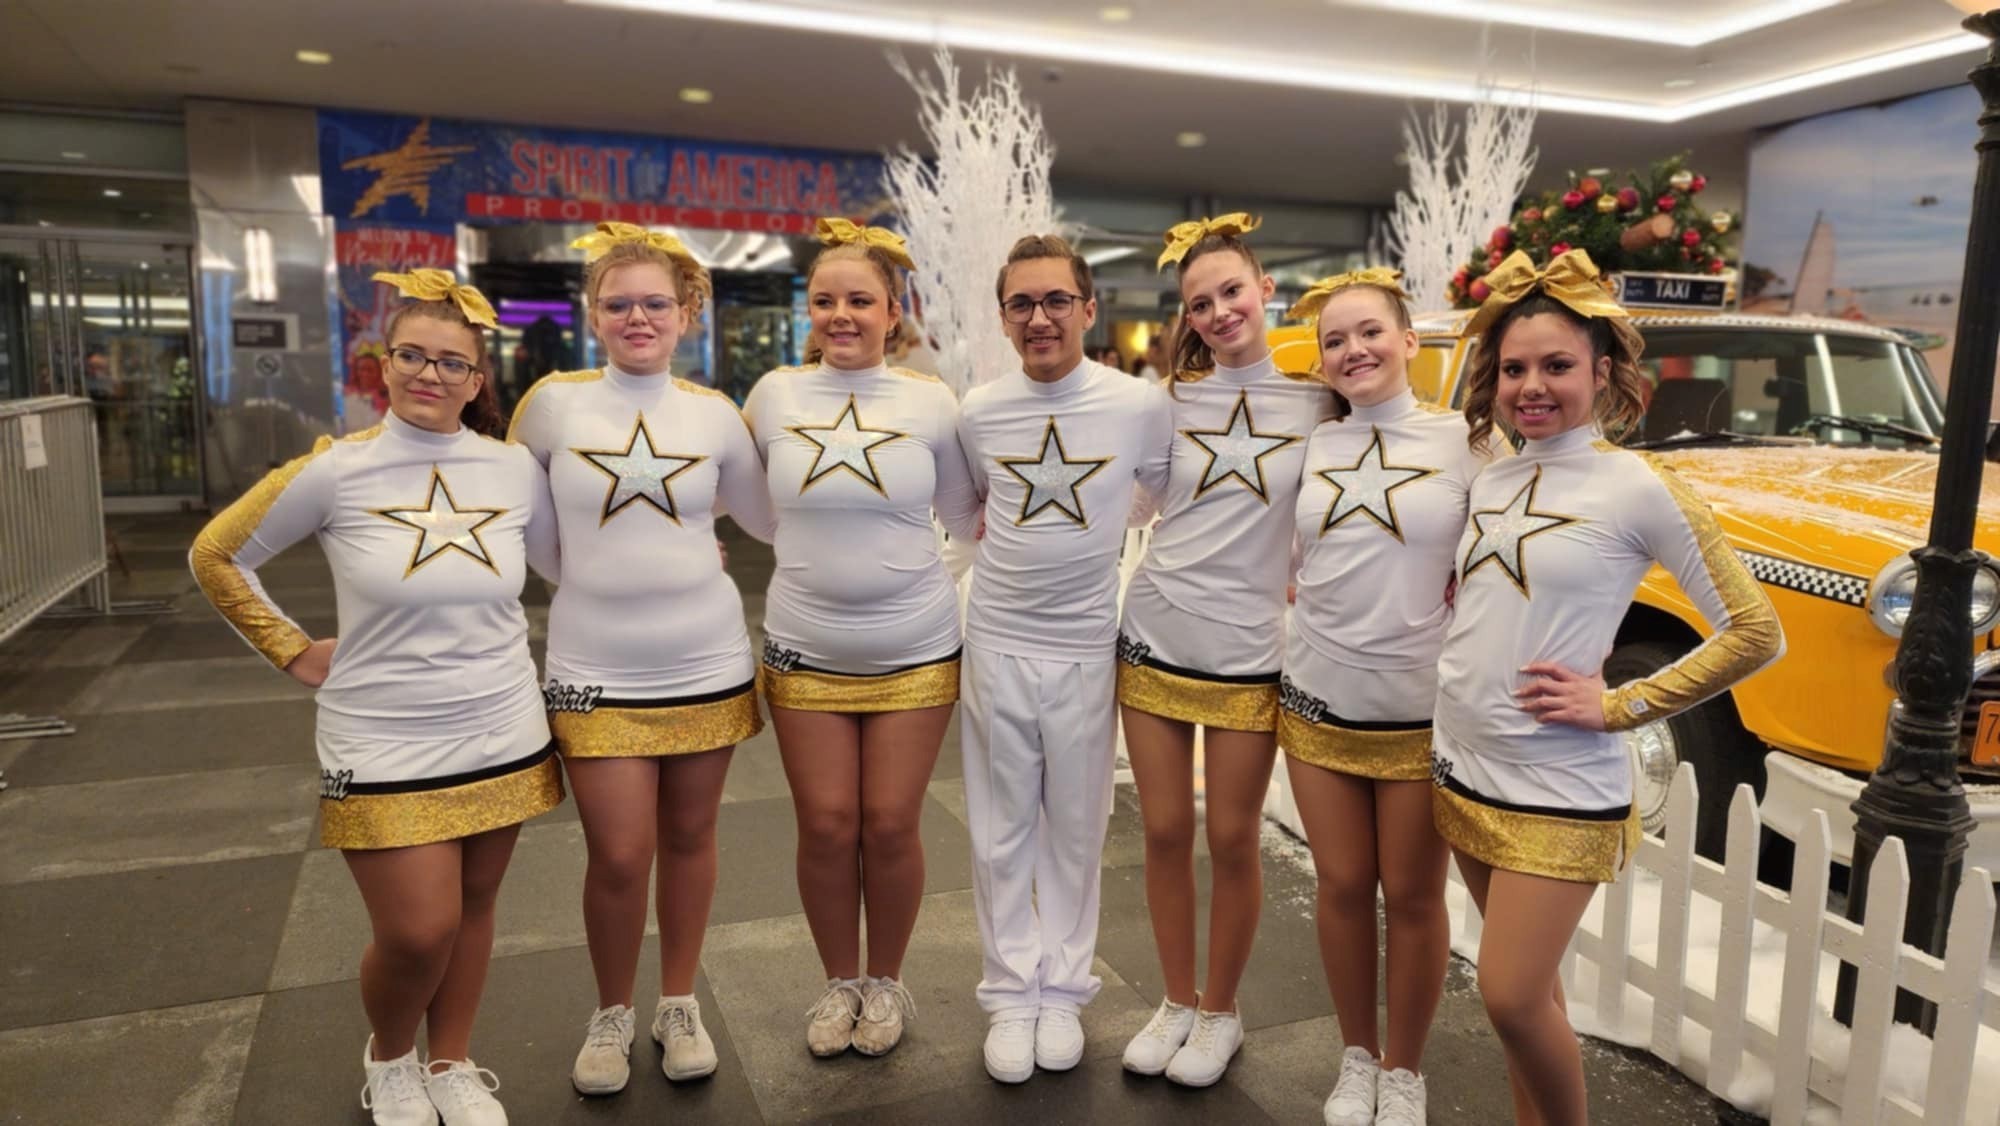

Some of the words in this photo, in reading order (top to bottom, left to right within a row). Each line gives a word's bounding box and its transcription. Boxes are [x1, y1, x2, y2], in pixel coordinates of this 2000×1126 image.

[511, 139, 634, 199] SPIRIT
[666, 148, 841, 213] AMERICA
[485, 196, 818, 236] PRODUCTION
[1655, 279, 1691, 299] TAXI
[544, 679, 603, 714] Spirit
[1280, 675, 1328, 724] Spirit
[1985, 713, 2000, 745] 7
